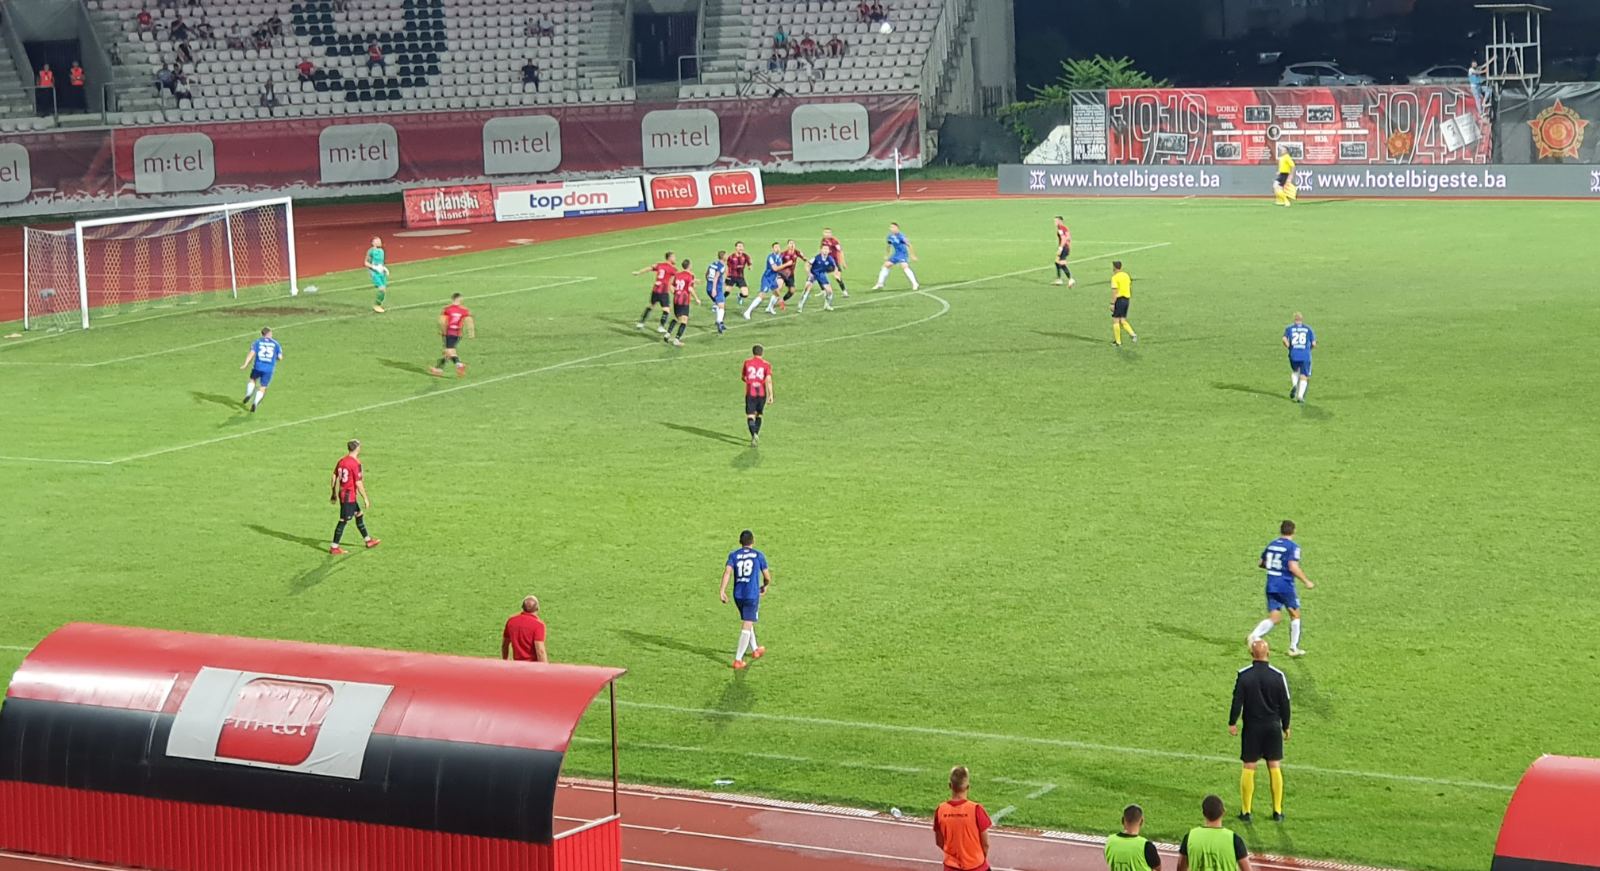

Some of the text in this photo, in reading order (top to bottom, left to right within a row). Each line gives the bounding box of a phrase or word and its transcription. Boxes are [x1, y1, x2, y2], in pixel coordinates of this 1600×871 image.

[652, 124, 710, 148] m:tel
[801, 119, 859, 143] m:tel
[329, 139, 388, 163] m:tel
[492, 131, 551, 154] m:tel
[143, 149, 204, 173] m:tel
[656, 183, 693, 199] m:tel
[714, 180, 751, 196] m:tel
[1050, 170, 1220, 191] www.hotelbigeste.ba
[1318, 170, 1507, 192] www.hotelbigeste.ba
[529, 191, 608, 210] topdom
[747, 366, 765, 380] 24
[736, 559, 754, 577] 18
